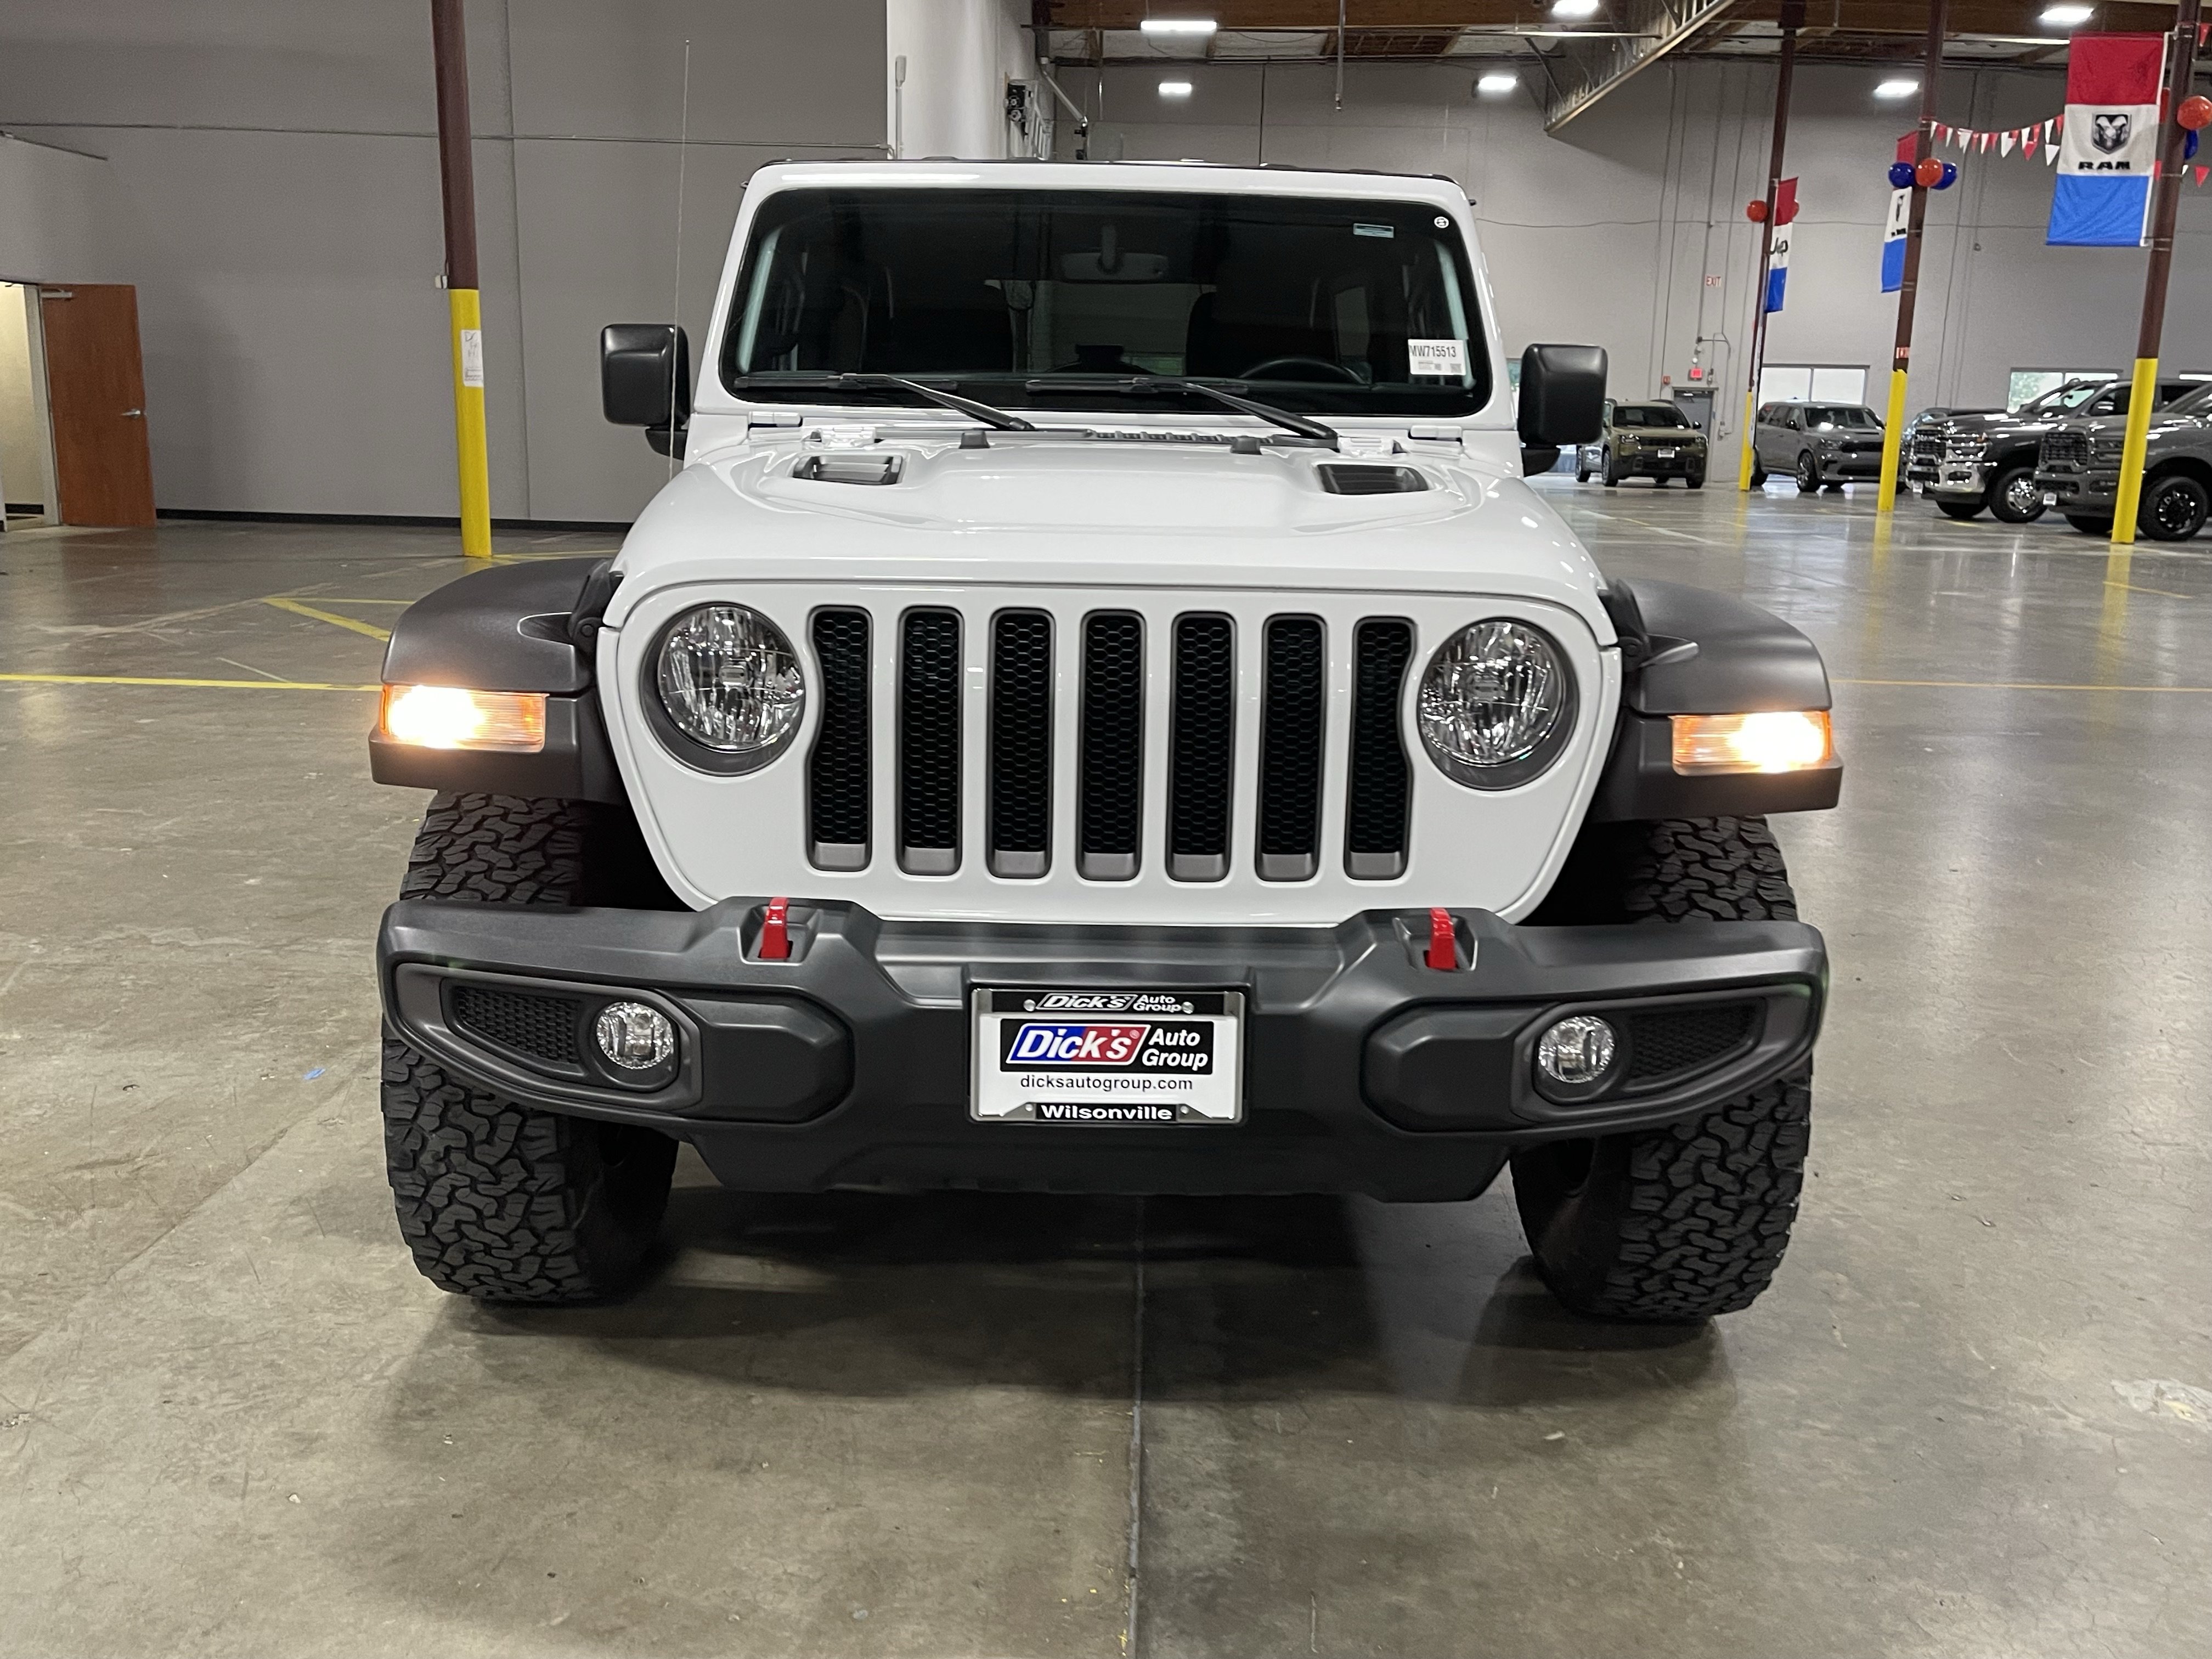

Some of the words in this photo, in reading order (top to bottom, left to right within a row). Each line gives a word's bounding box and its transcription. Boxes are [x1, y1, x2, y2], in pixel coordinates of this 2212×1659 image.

[2078, 161, 2130, 170] RAM
[1706, 276, 1721, 286] EXIT
[1043, 995, 1127, 1008] Dick's
[1136, 994, 1176, 1004] Auto
[1133, 1002, 1182, 1013] Group
[1017, 1028, 1132, 1060] Dick's
[1148, 1028, 1200, 1046] Auto
[1142, 1048, 1208, 1071] Group
[1020, 1075, 1193, 1092] dicksautogroup.com
[1040, 1104, 1172, 1120] Wilsonville
